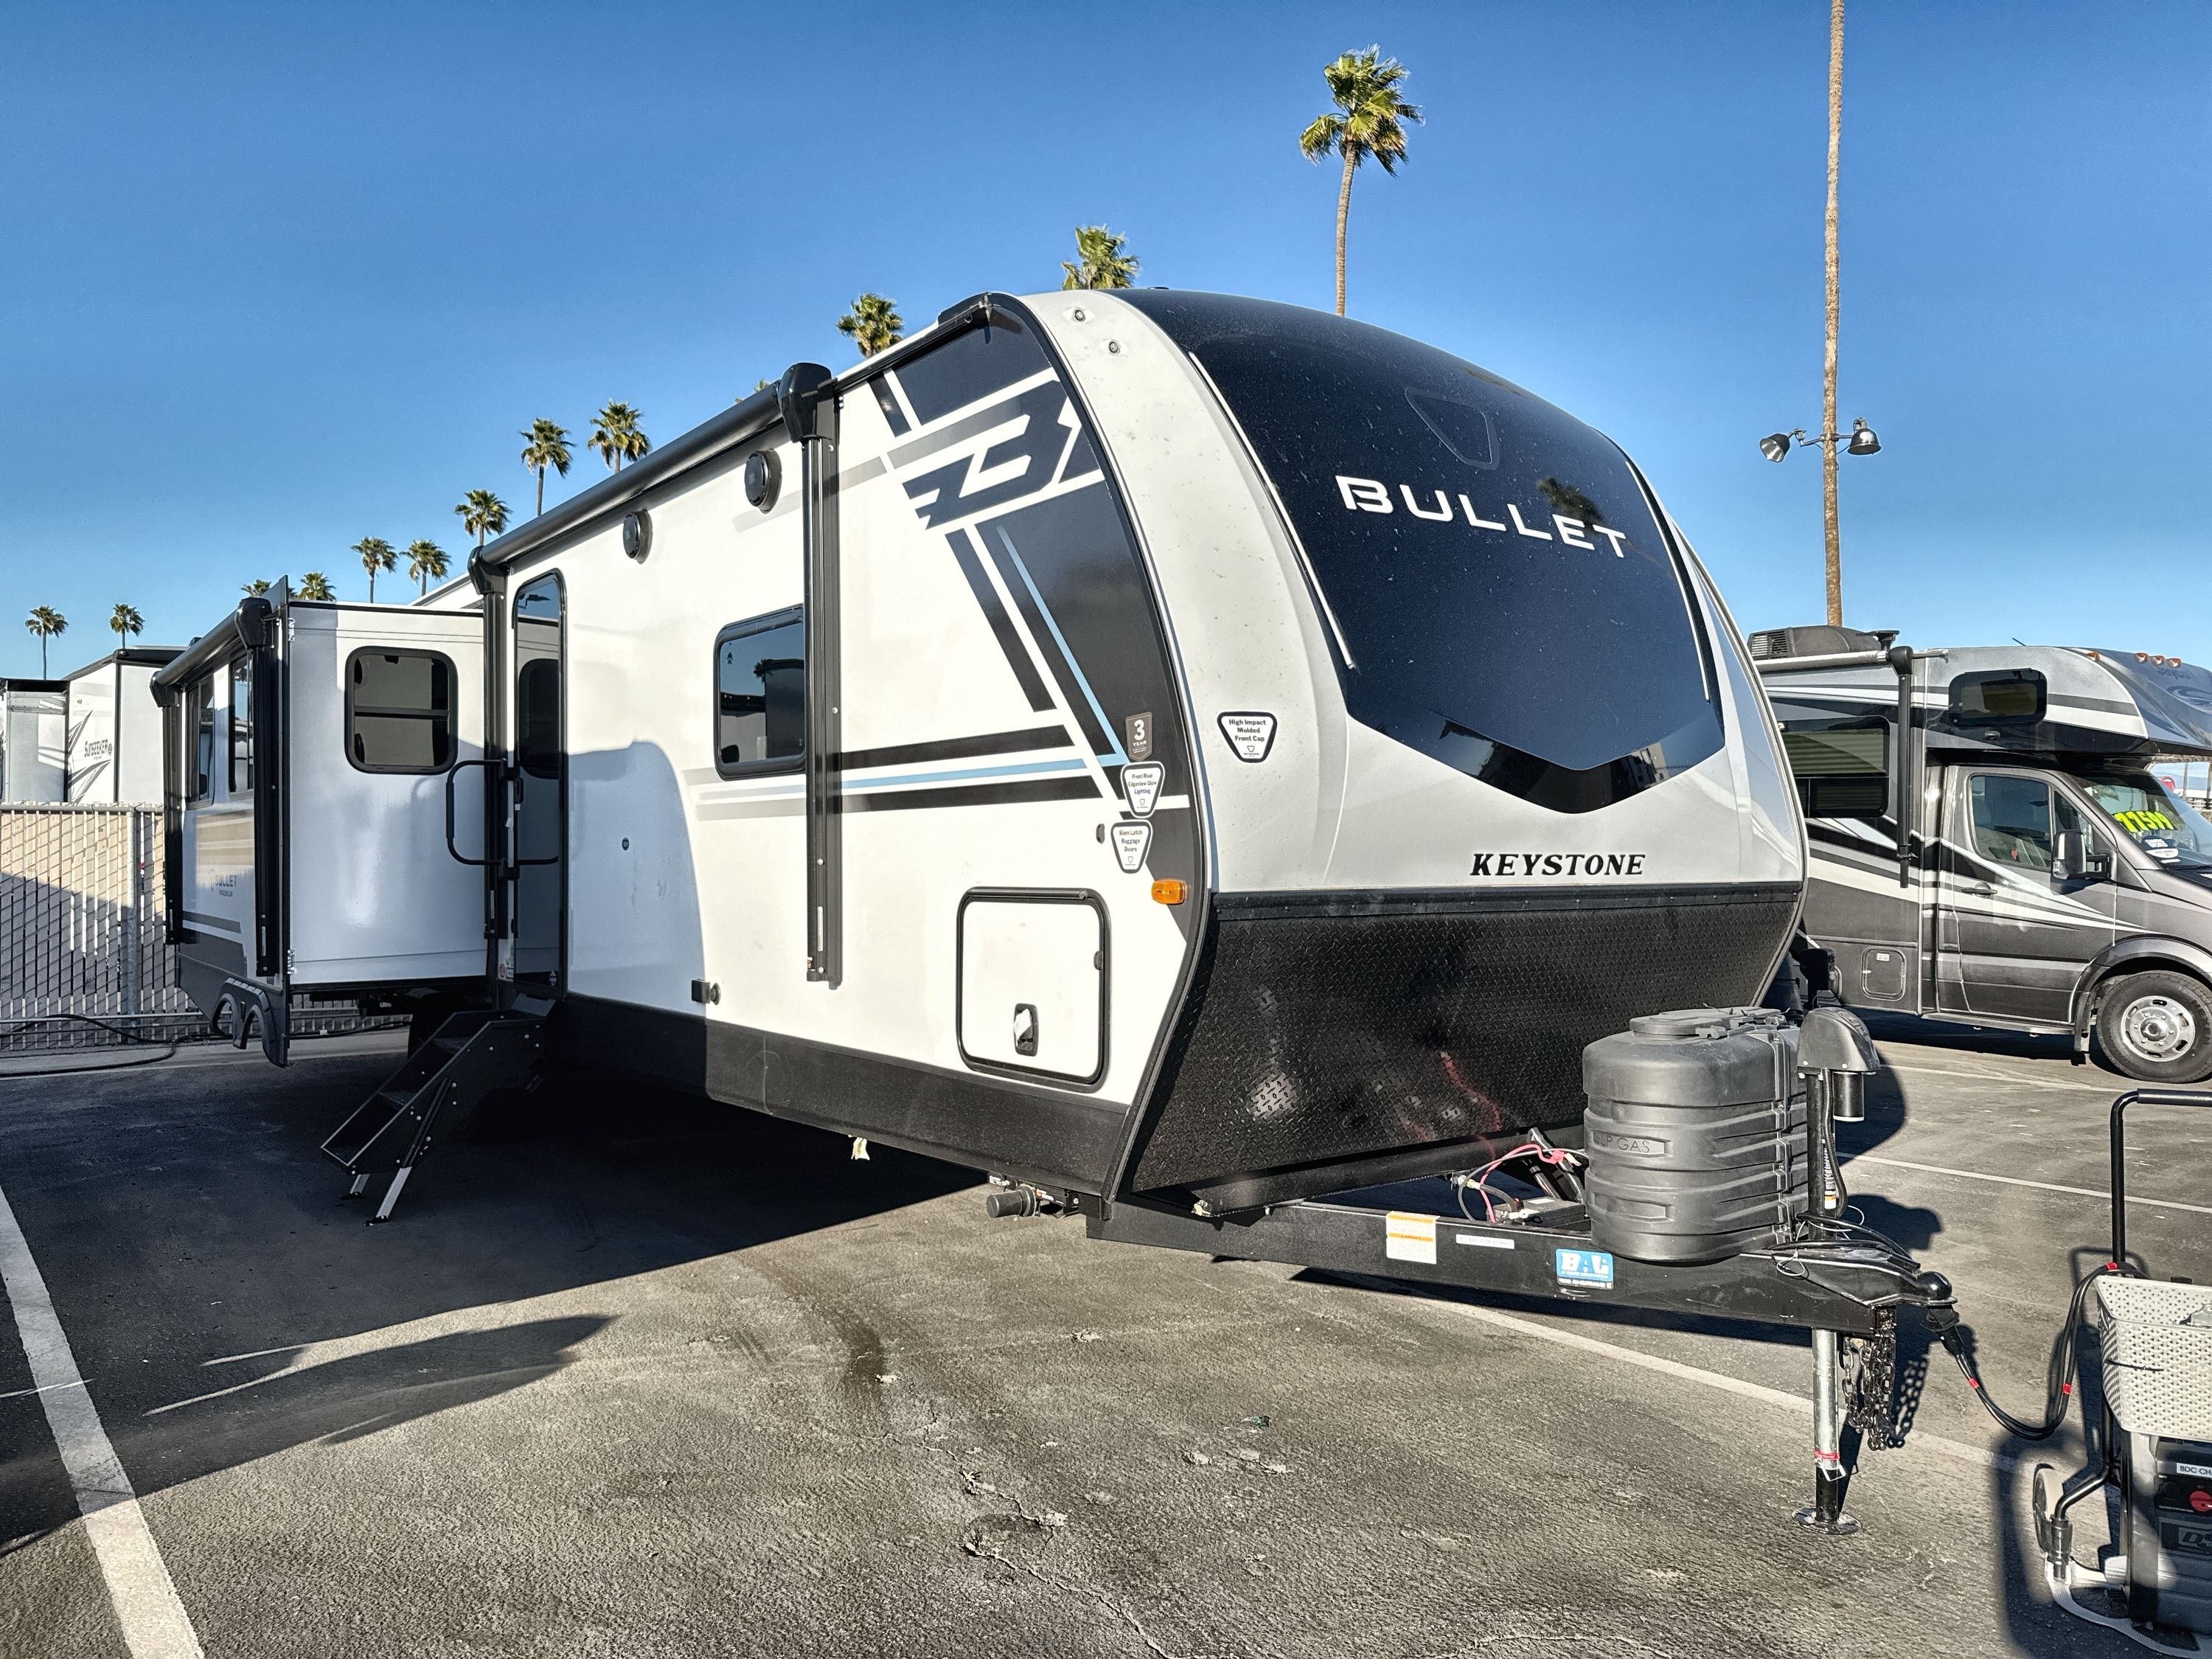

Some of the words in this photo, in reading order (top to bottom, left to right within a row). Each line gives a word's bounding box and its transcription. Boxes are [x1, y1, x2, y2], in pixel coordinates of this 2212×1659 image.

[1335, 475, 1627, 558] BULLET
[1134, 719, 1145, 741] 3
[1470, 853, 1646, 876] KEYSTONE
[1617, 1137, 1650, 1153] GAS
[2180, 1465, 2197, 1474] BDC
